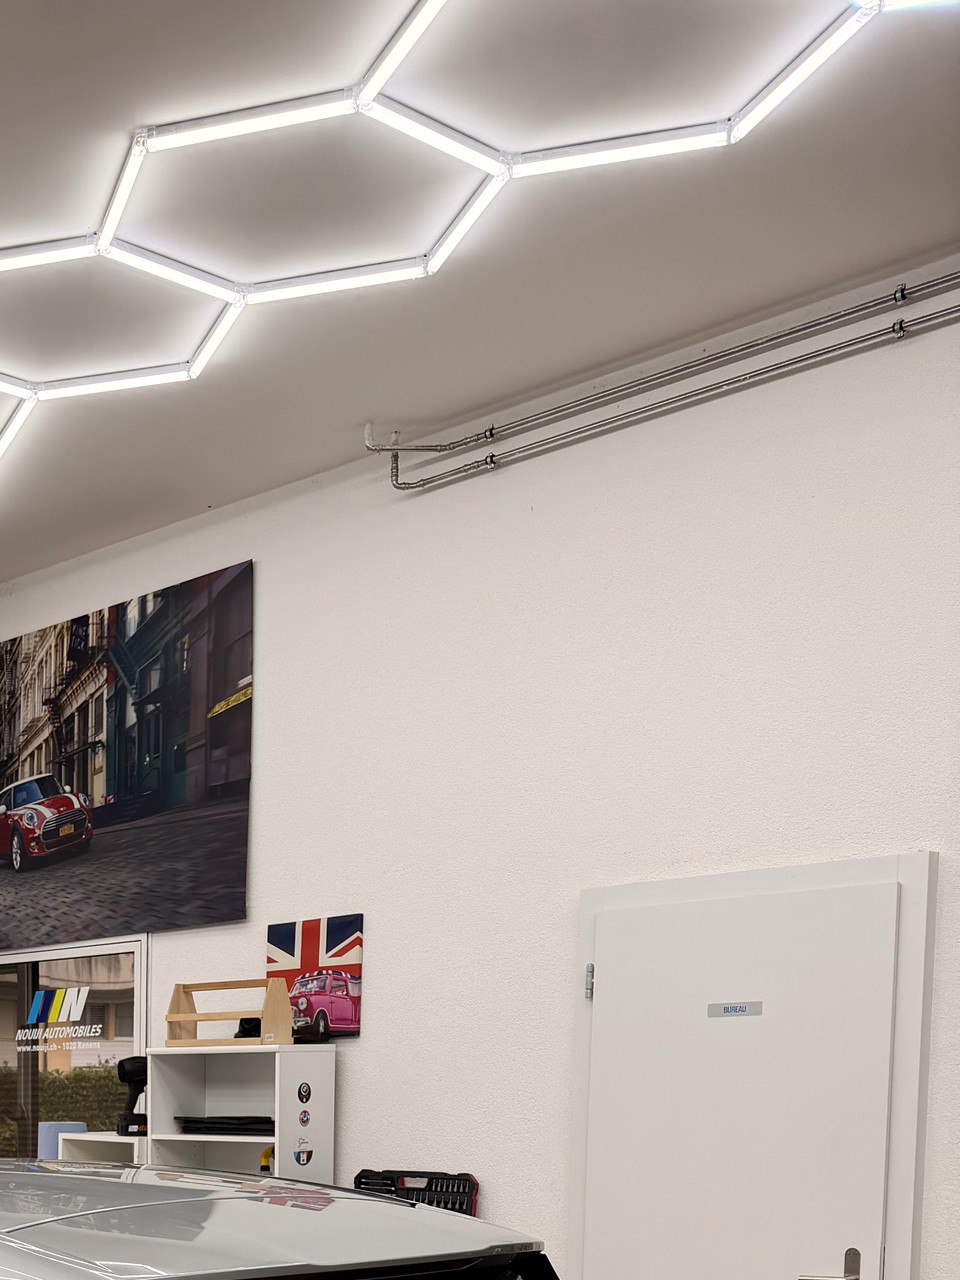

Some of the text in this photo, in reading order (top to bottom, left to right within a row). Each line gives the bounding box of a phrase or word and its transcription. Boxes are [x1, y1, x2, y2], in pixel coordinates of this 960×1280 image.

[723, 1005, 747, 1014] BUREAU
[15, 1024, 102, 1041] NOUIJI AUTOMOBILES
[62, 1042, 77, 1051] 1020
[78, 1042, 100, 1050] Renens
